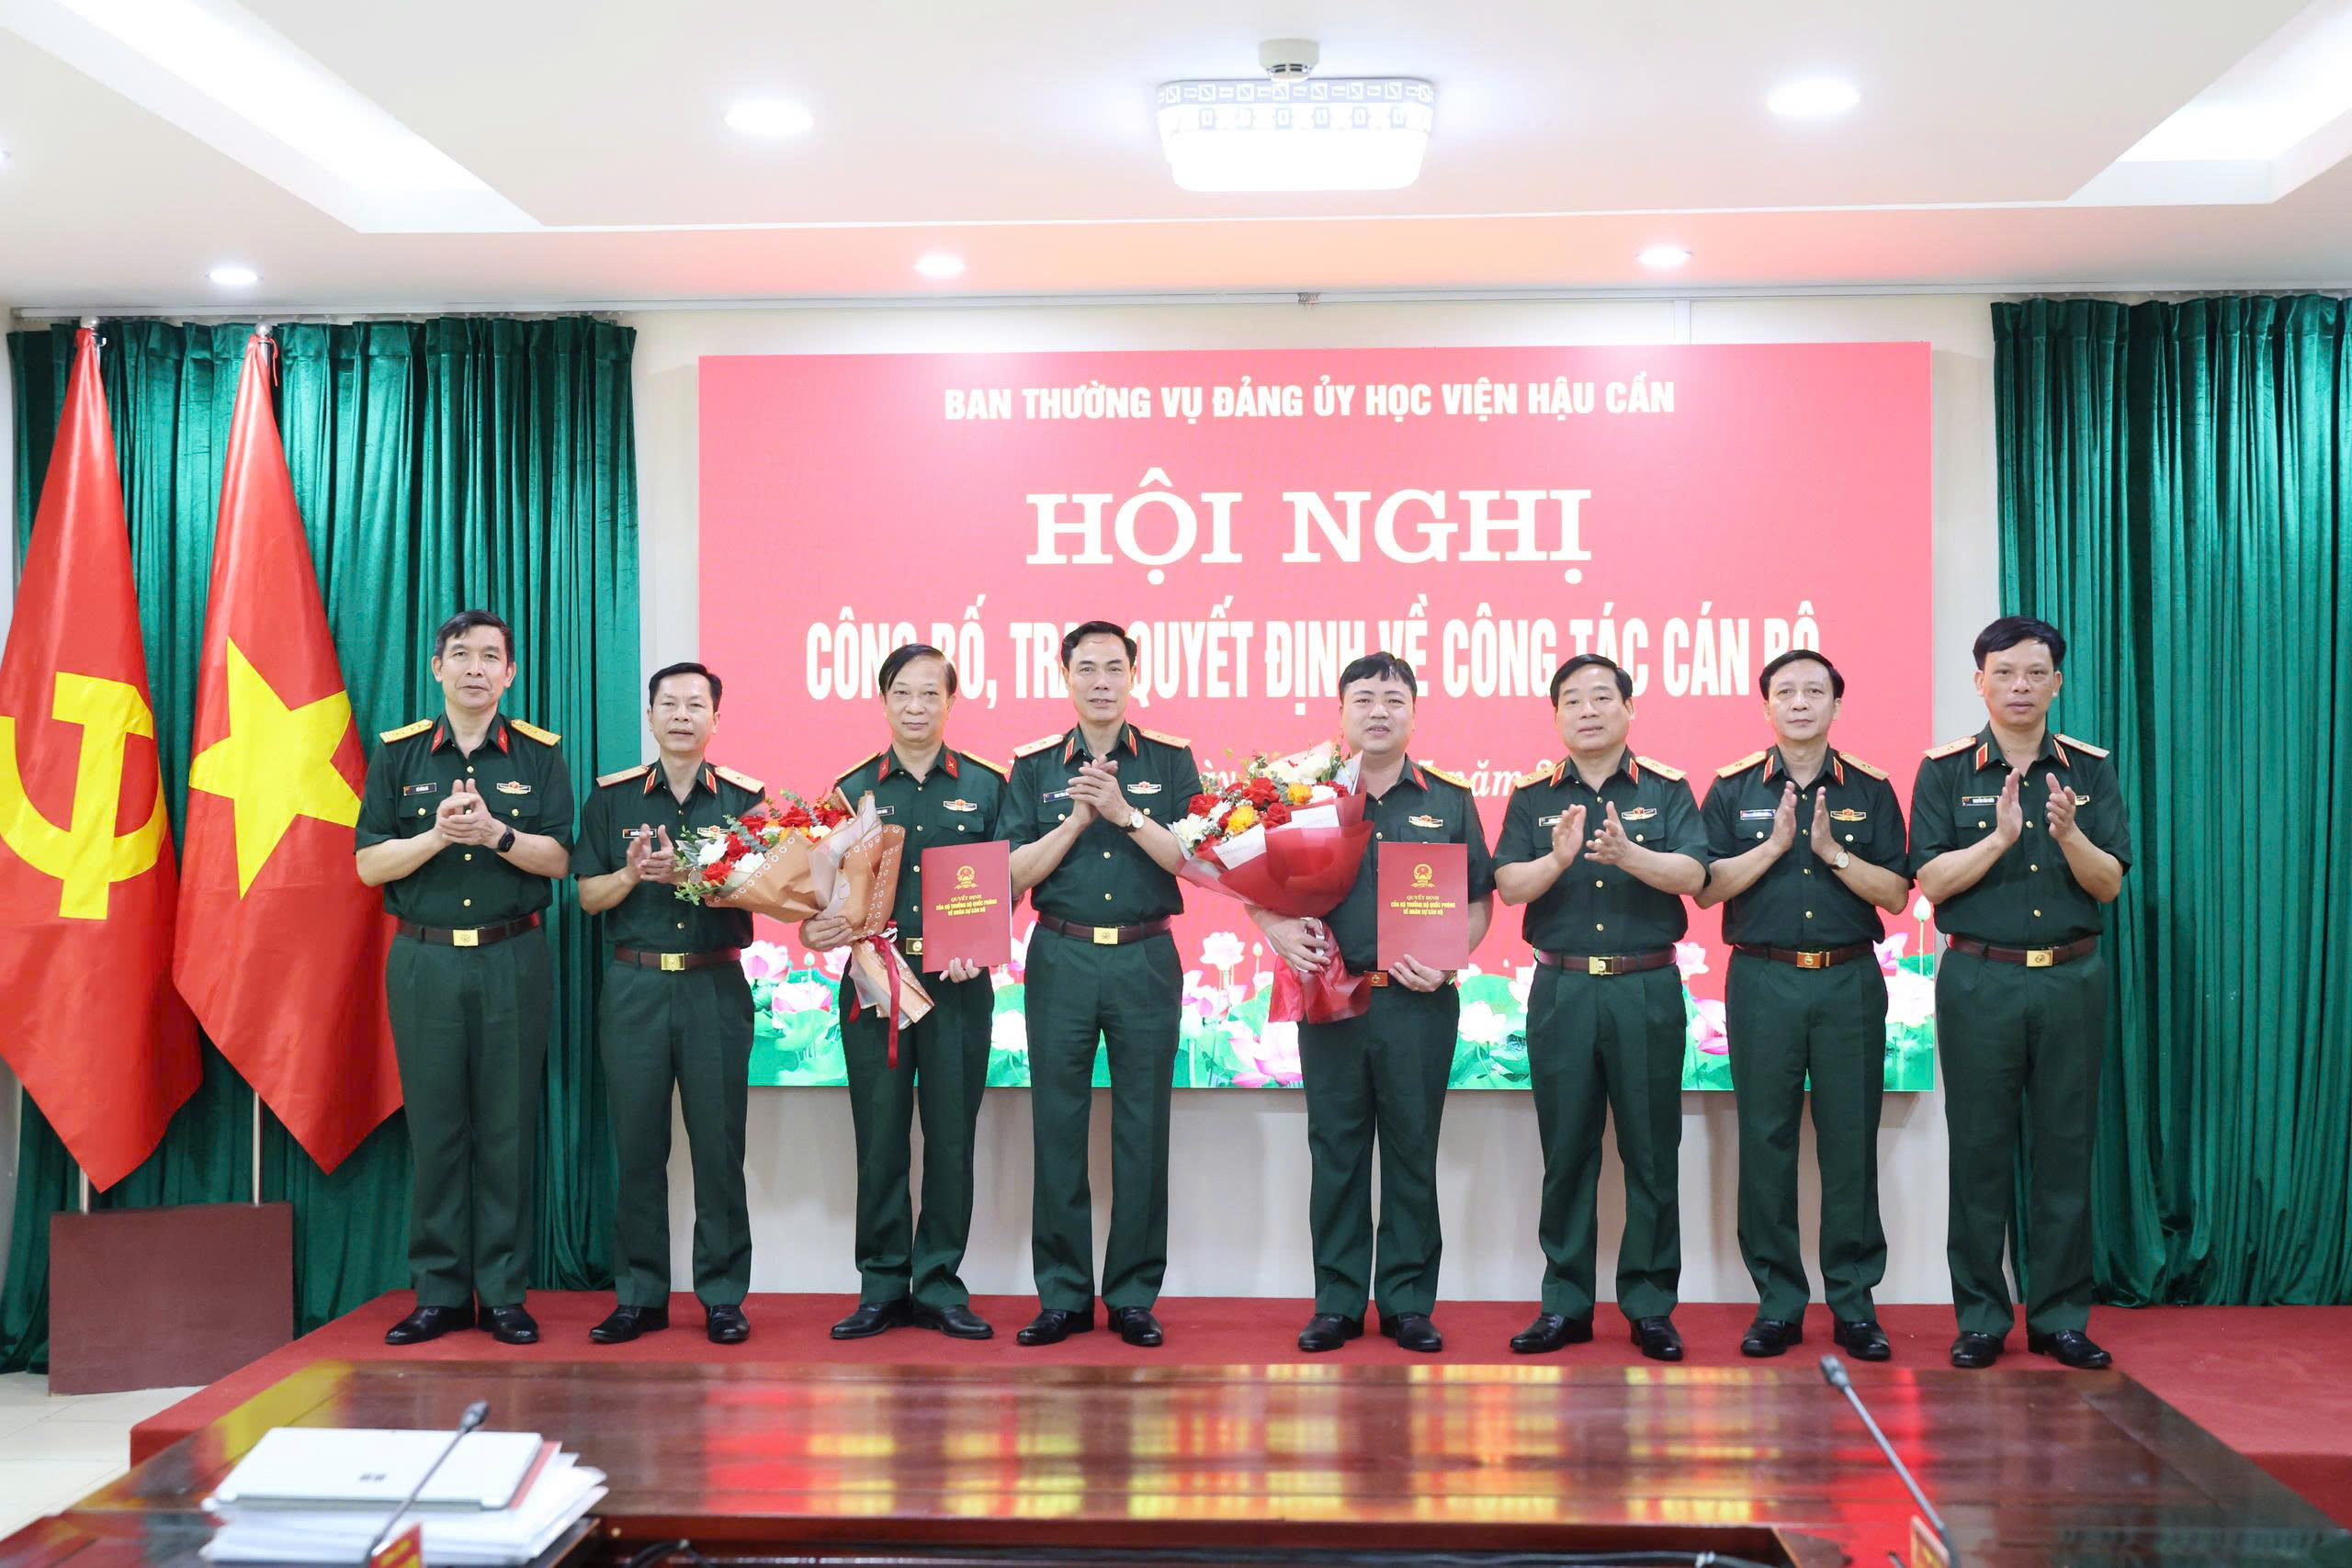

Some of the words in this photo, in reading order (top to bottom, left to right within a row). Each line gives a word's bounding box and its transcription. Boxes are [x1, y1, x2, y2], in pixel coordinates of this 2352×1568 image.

[944, 389, 1012, 420] BAN
[1022, 379, 1151, 420] THƯỜNG
[1161, 387, 1203, 424] VỤ
[1212, 375, 1304, 417] ĐẢNG
[1314, 374, 1356, 417] ỦY
[1365, 384, 1431, 423] HỌC
[1442, 377, 1518, 421] VIỆN
[1528, 376, 1596, 422] HẬU
[1605, 369, 1675, 413] CẦN
[1025, 467, 1243, 586] HỘI
[1282, 488, 1592, 586] NGHỊ
[1010, 622, 1080, 699] TR
[1126, 594, 1254, 708] QUYẾT
[1442, 602, 1557, 698] CÔNG
[1663, 601, 1750, 697] CÁN
